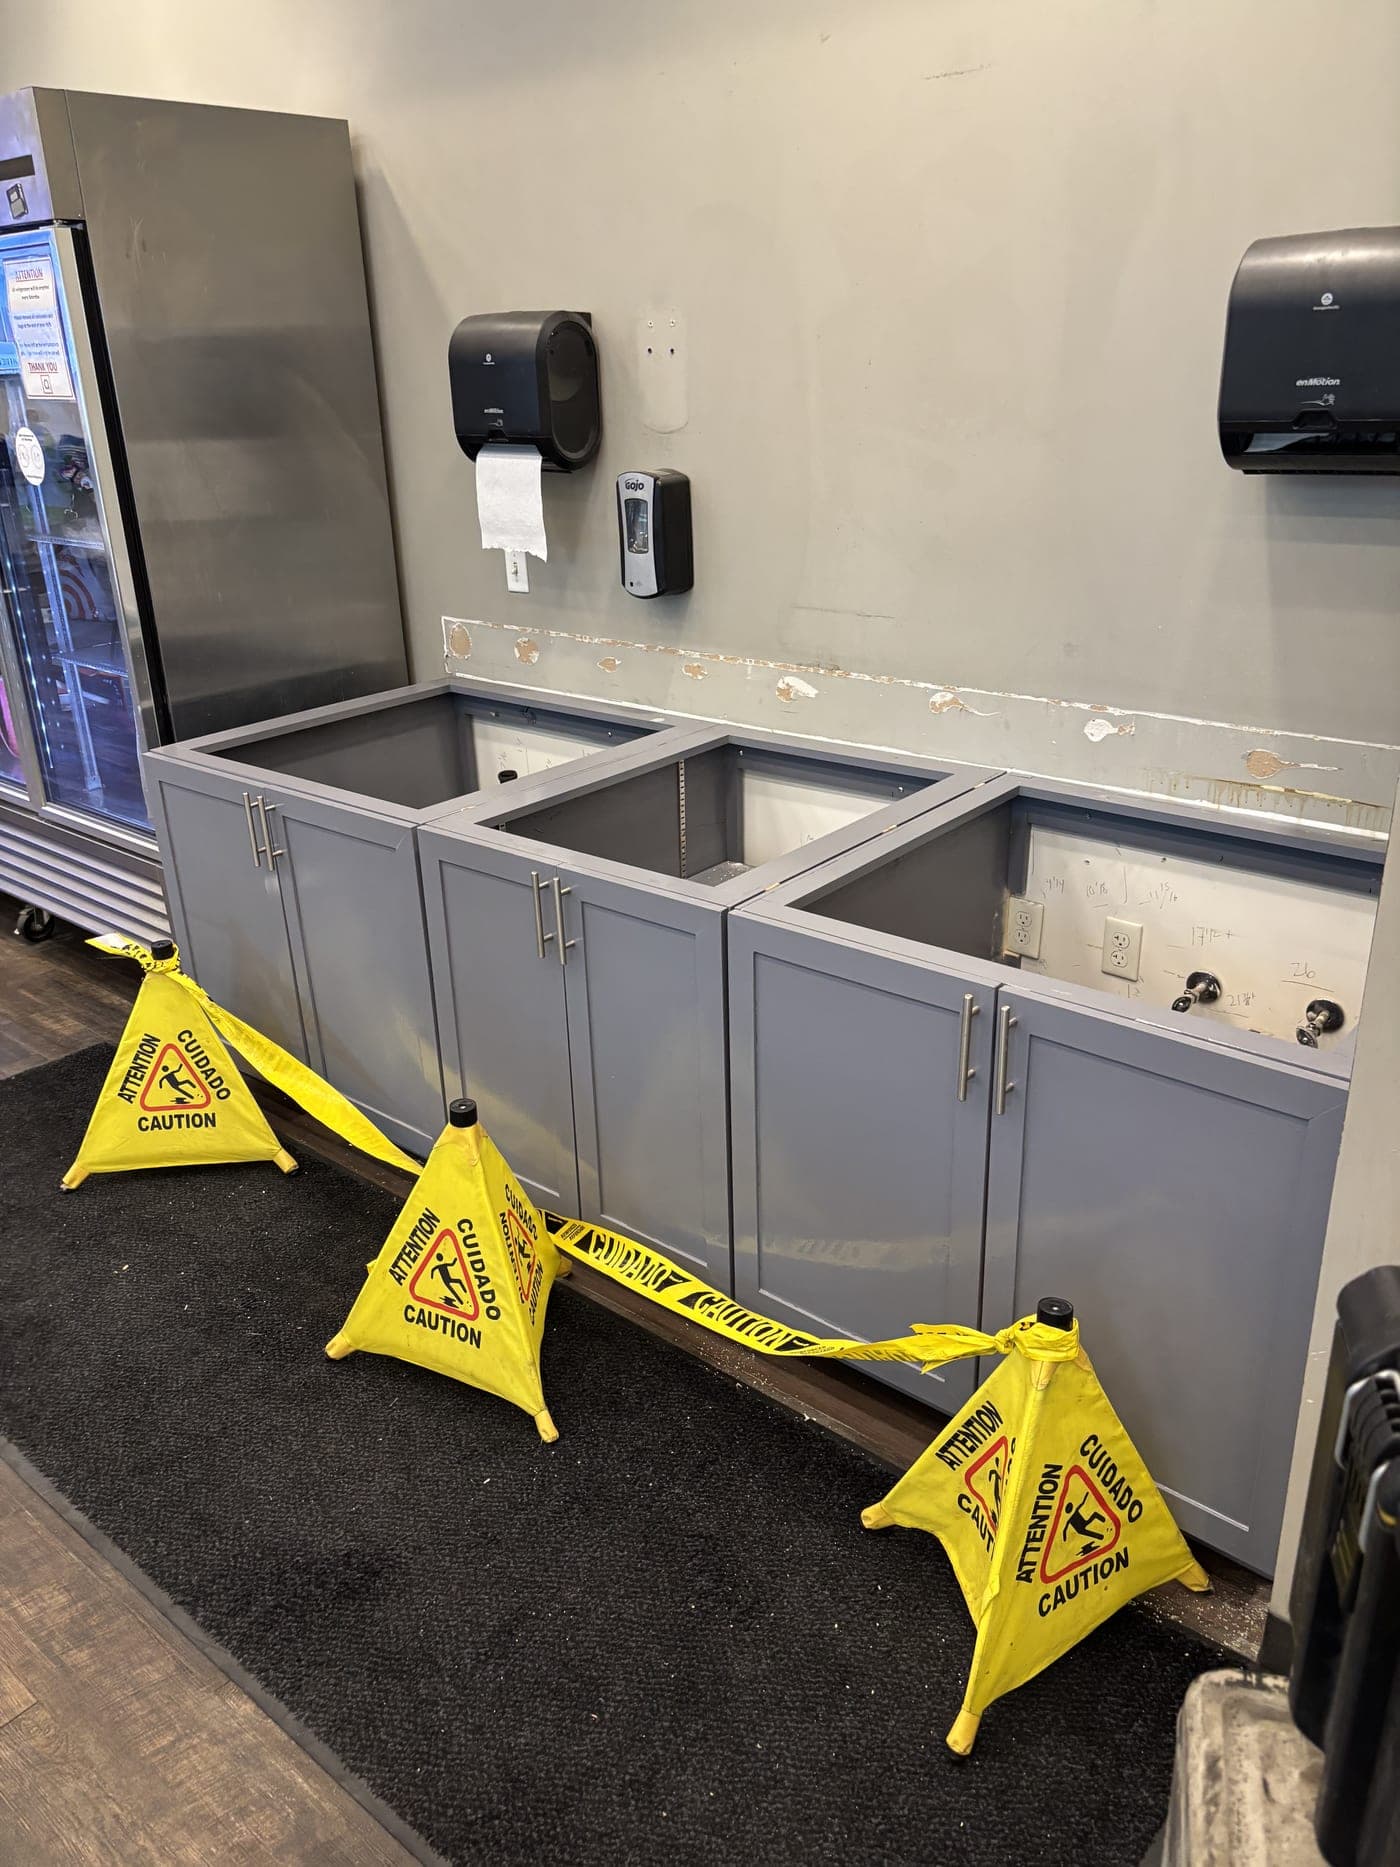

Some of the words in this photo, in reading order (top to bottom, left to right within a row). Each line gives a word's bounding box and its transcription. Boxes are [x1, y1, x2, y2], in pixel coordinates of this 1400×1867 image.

[16, 267, 44, 281] ATTENTION
[28, 362, 46, 372] THANK
[46, 362, 58, 371] YOU
[1295, 377, 1341, 386] enMotion
[117, 1033, 161, 1104] ATTENTION
[177, 1029, 231, 1101] CUIDADO
[137, 1112, 217, 1132] CAUTION
[388, 1207, 441, 1286] ATTENTION
[457, 1218, 501, 1321] CUIDADO
[588, 1231, 672, 1291] CUIDADO
[403, 1304, 482, 1349] CAUTION
[693, 1292, 792, 1351] CAUTION
[935, 1400, 1004, 1471] ATTENTION
[1079, 1434, 1143, 1523] CUIDADO
[957, 1493, 996, 1562] CAUT
[1015, 1464, 1063, 1584] ATTENTION
[1038, 1547, 1130, 1617] CAUTION
